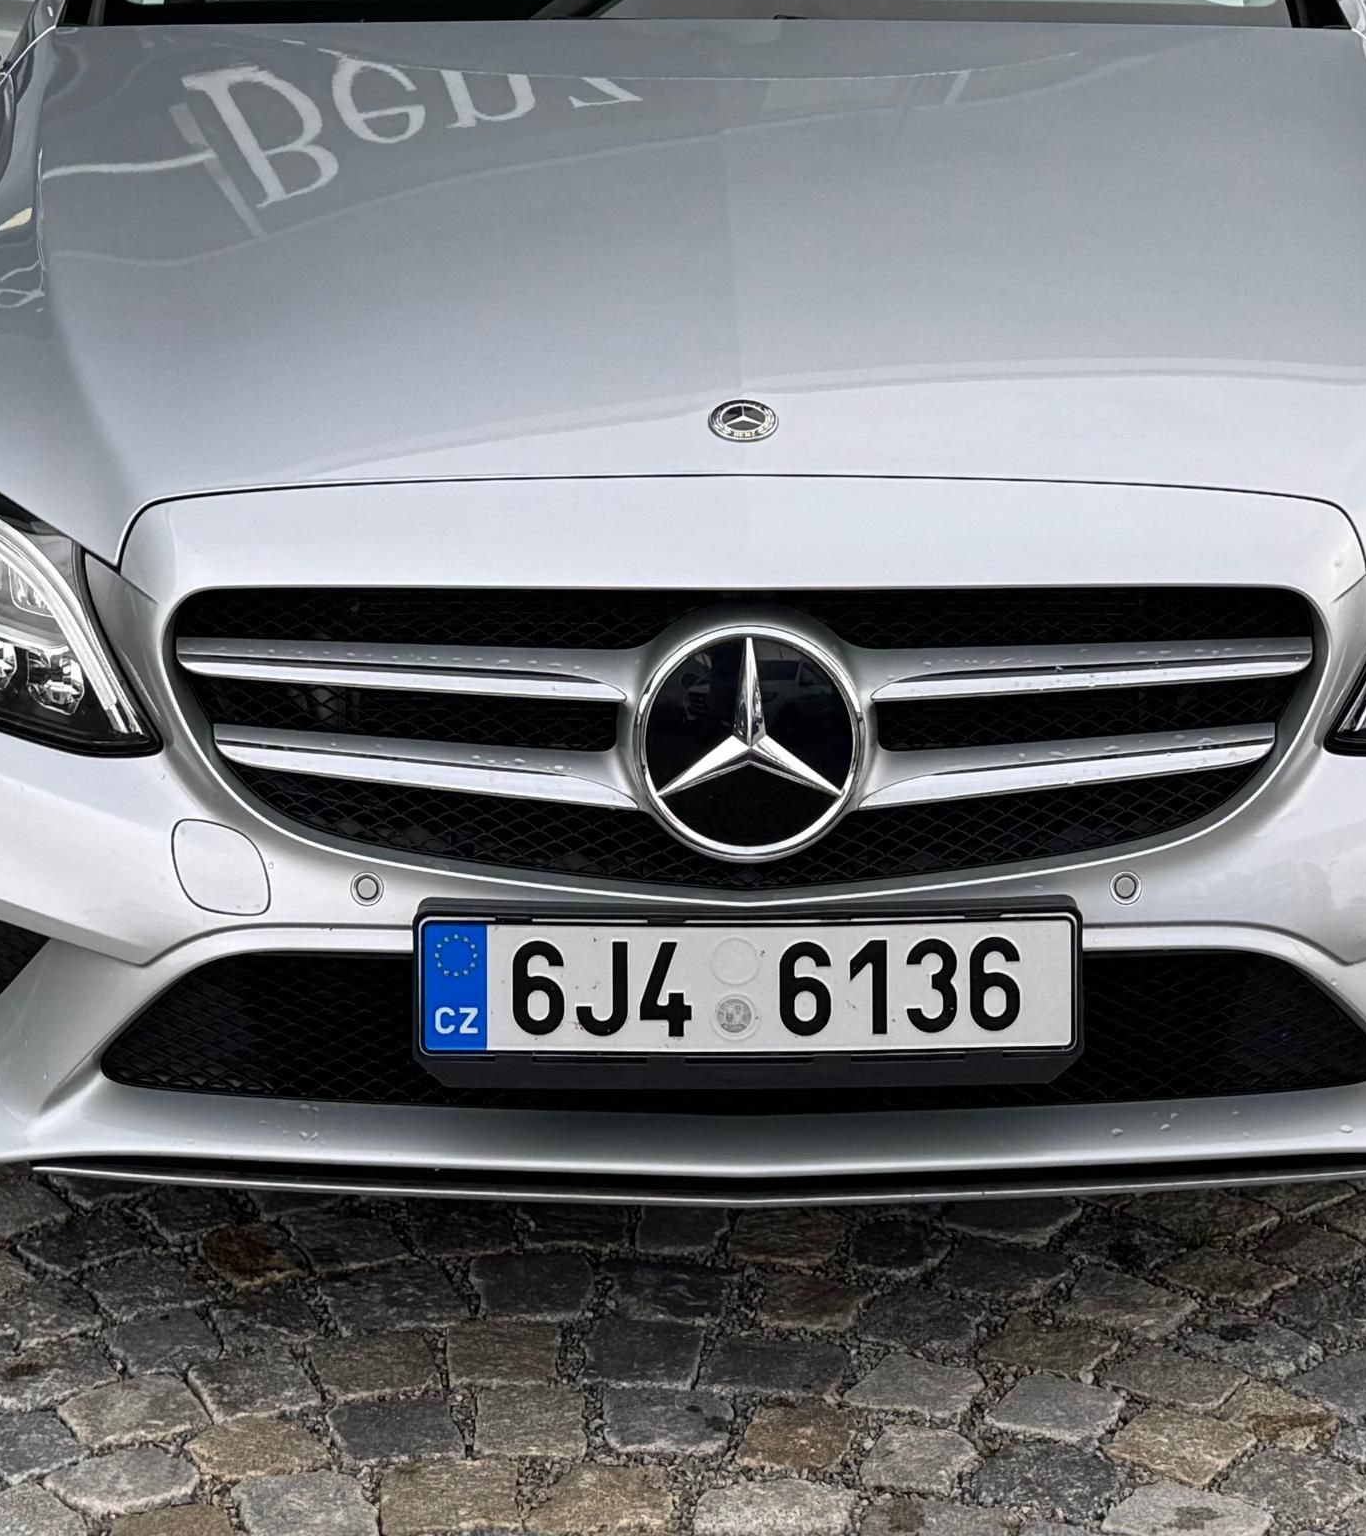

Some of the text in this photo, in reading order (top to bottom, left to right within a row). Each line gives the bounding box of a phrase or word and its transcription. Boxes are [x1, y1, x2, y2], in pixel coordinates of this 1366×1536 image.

[511, 936, 1022, 1038] 6J4 6136
[434, 1006, 479, 1034] CZ
